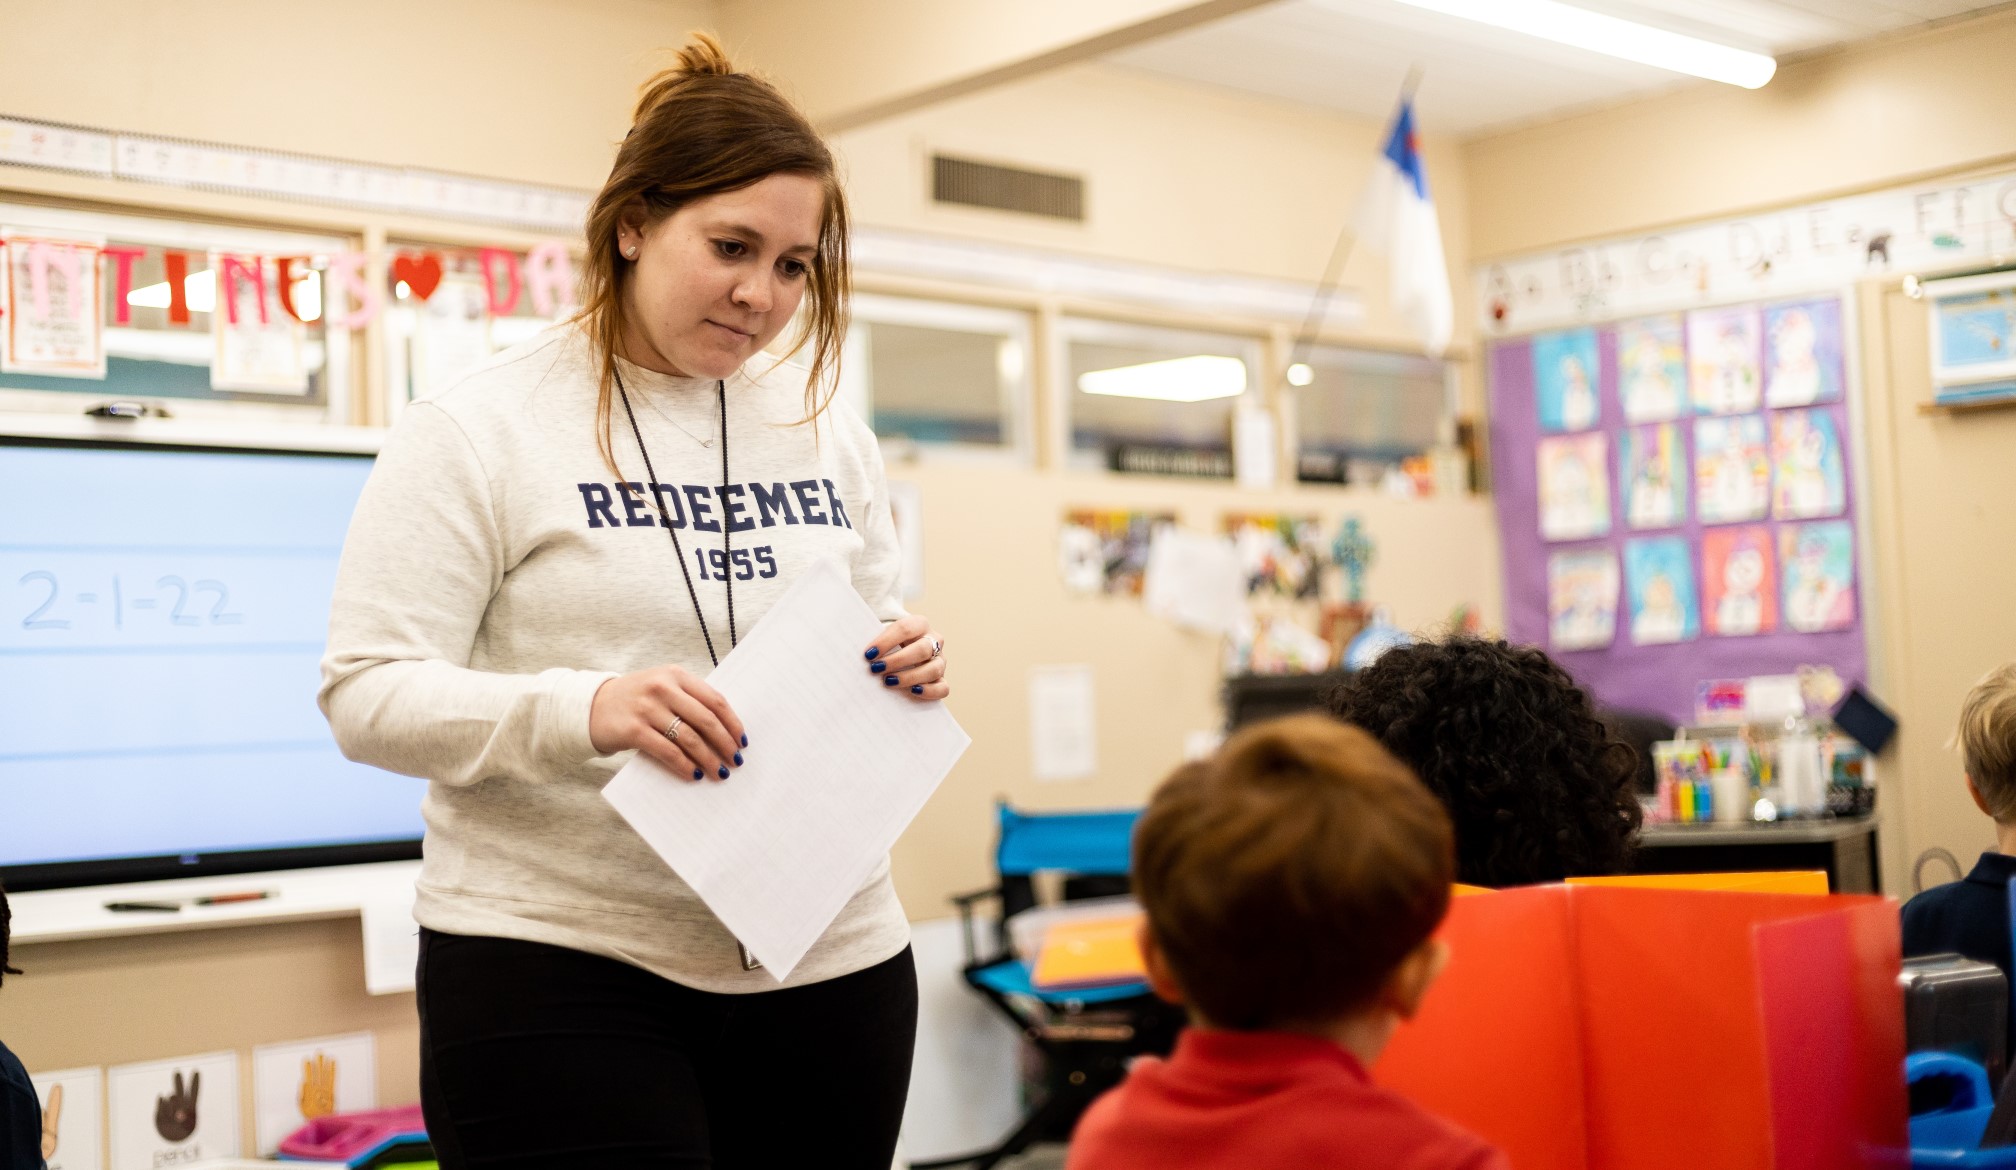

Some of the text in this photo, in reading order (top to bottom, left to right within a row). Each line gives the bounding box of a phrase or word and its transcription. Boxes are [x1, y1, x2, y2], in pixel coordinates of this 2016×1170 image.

[0, 239, 379, 330] NTINES
[695, 545, 777, 581] 1955
[19, 569, 243, 629] 2-1-22
